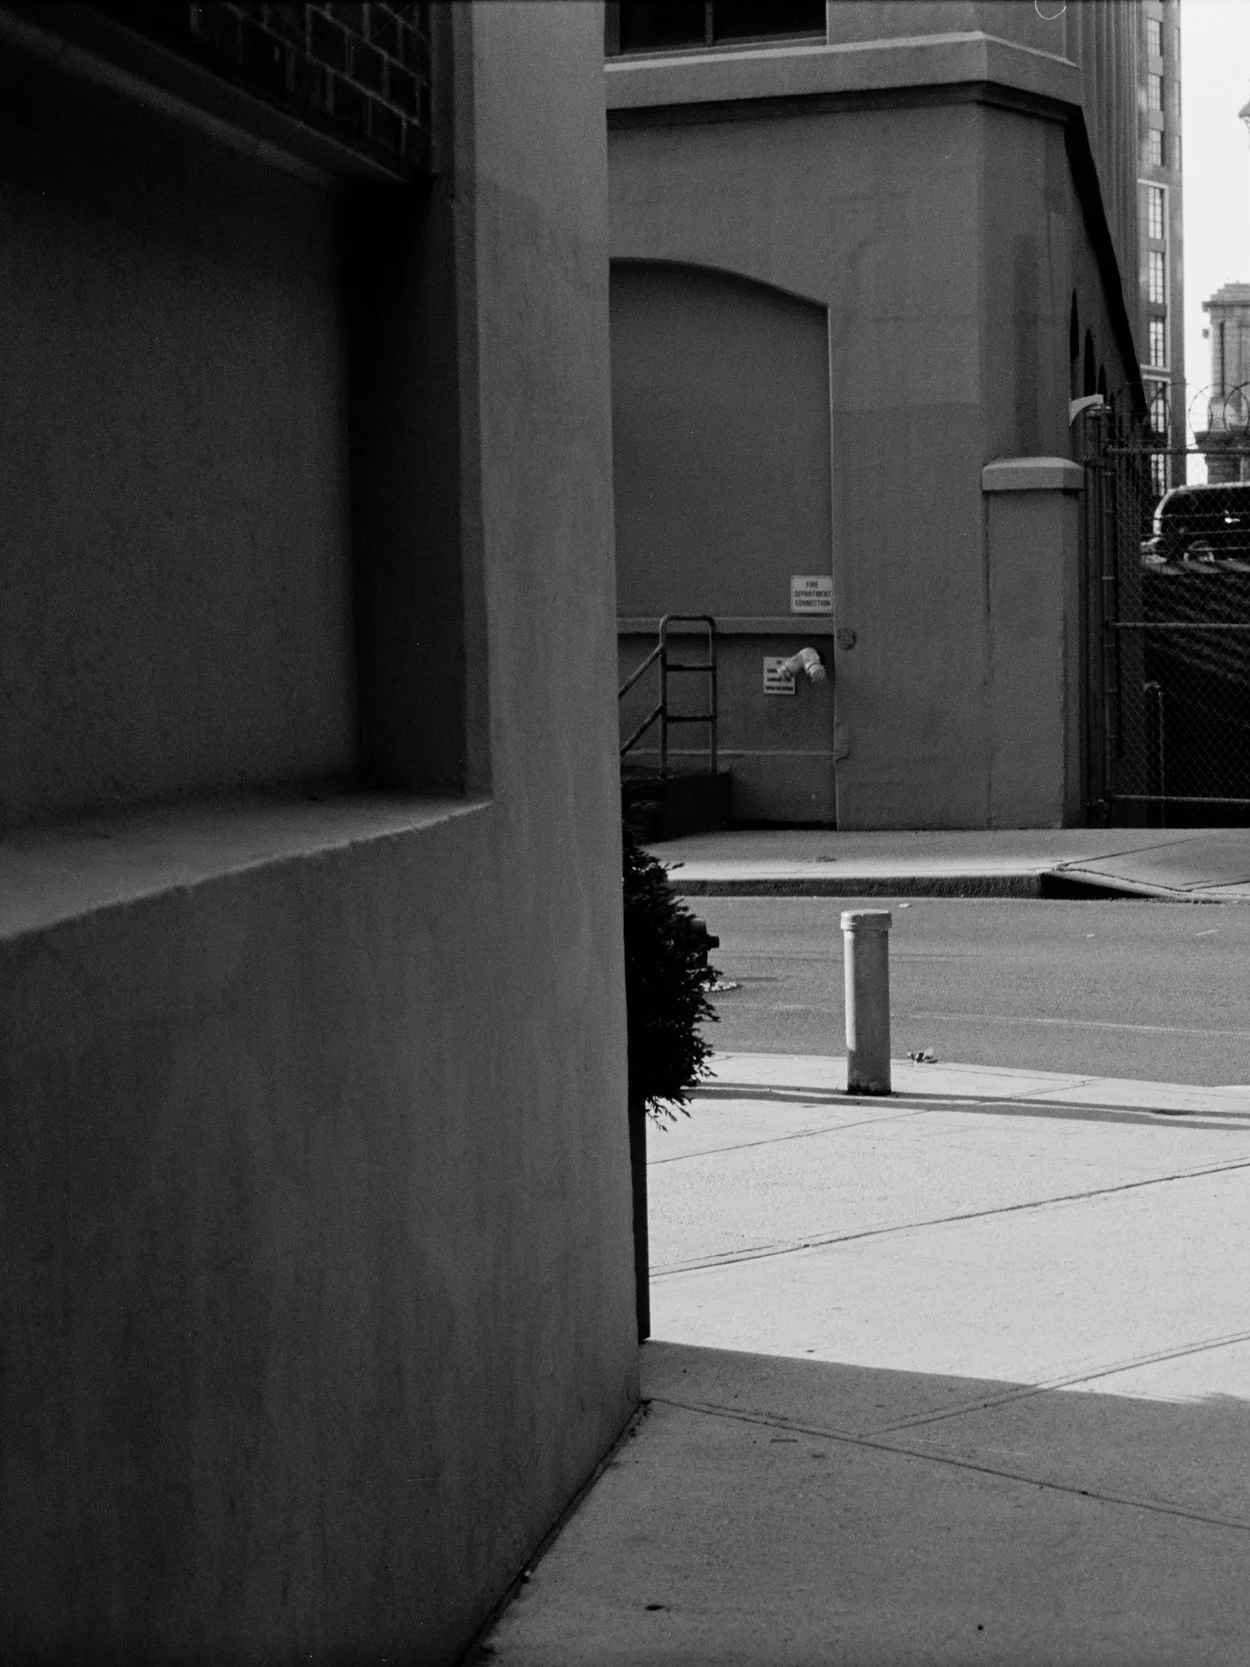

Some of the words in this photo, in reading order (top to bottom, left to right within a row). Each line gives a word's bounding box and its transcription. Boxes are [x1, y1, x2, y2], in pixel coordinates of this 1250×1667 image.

[806, 580, 818, 588] FIRE
[794, 590, 832, 598] DEPARTMENT
[795, 599, 831, 607] CONNECTION
